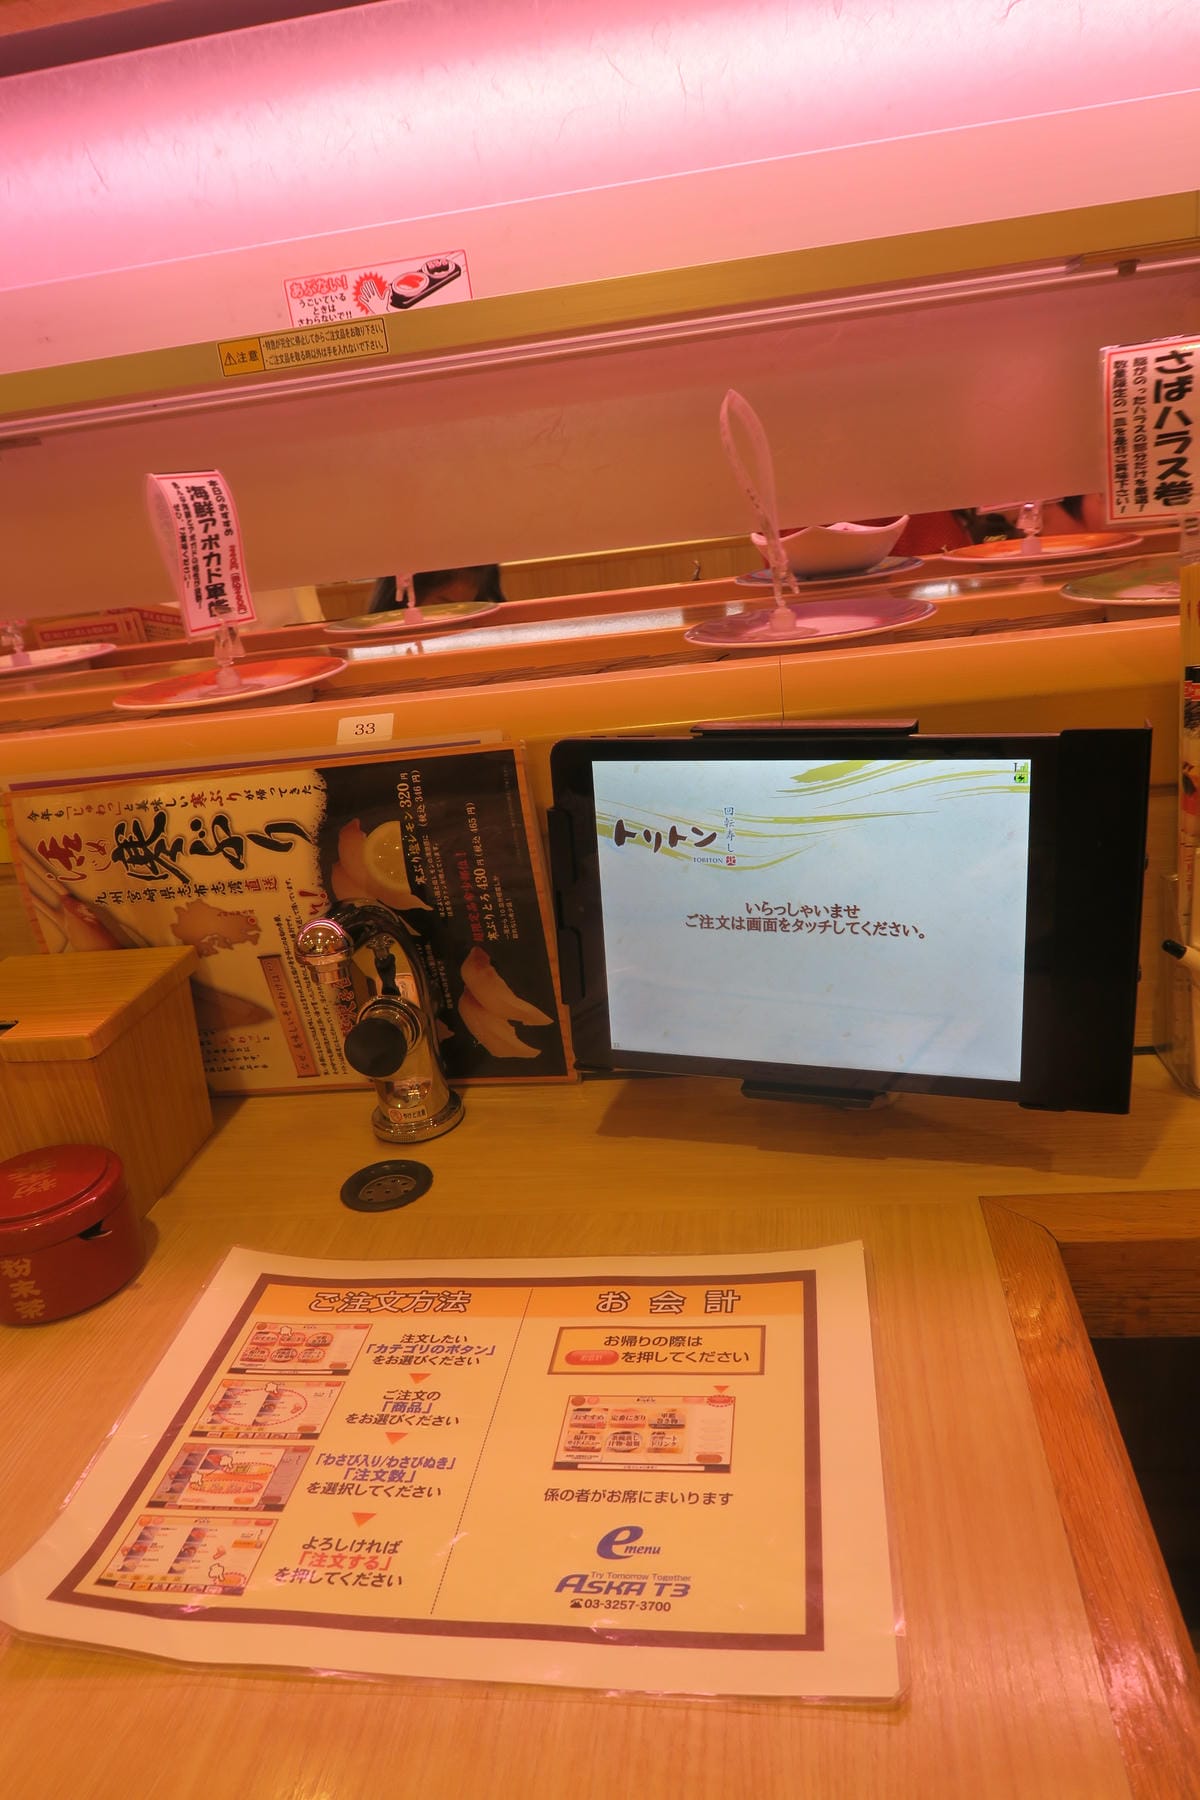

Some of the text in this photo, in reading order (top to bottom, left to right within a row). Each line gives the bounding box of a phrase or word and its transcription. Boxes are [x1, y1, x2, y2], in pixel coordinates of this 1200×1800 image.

[313, 304, 336, 316] ときは
[236, 350, 259, 363] 注意
[1153, 350, 1194, 507] さばハラス巻
[207, 480, 233, 537] 本日のおすすめ
[355, 723, 375, 735] 33
[614, 819, 717, 853] トリトン
[724, 806, 735, 852] 回転寿し
[480, 893, 499, 940] 寒ぶりとろ
[745, 901, 861, 918] いらっしゃいませ
[685, 914, 926, 939] ご注文は画面をタッチしてください。
[309, 1290, 471, 1313] ご注文方法
[400, 1333, 468, 1344] 注文したい
[603, 1334, 704, 1347] お帰りの際は
[364, 1344, 496, 1356] 「カテゴリのボタン」
[621, 1350, 750, 1364] を押してください
[371, 1354, 480, 1366] をお選びください
[382, 1389, 441, 1401] ご注文の
[381, 1401, 434, 1414] 「商品」
[345, 1413, 459, 1426] をお選びください
[342, 1468, 417, 1483] 「注文数」
[306, 1481, 442, 1498] を選択してください
[543, 1488, 734, 1506] 係の者がお席にまいります
[302, 1536, 403, 1554] よろしければ
[624, 1544, 661, 1555] menu
[297, 1551, 393, 1570] 「注文する」
[273, 1567, 403, 1587] を押してください
[590, 1571, 692, 1582] Try Tomorrow Together
[554, 1574, 691, 1598] ASKA T3
[584, 1598, 672, 1612] 03-3257-3700
